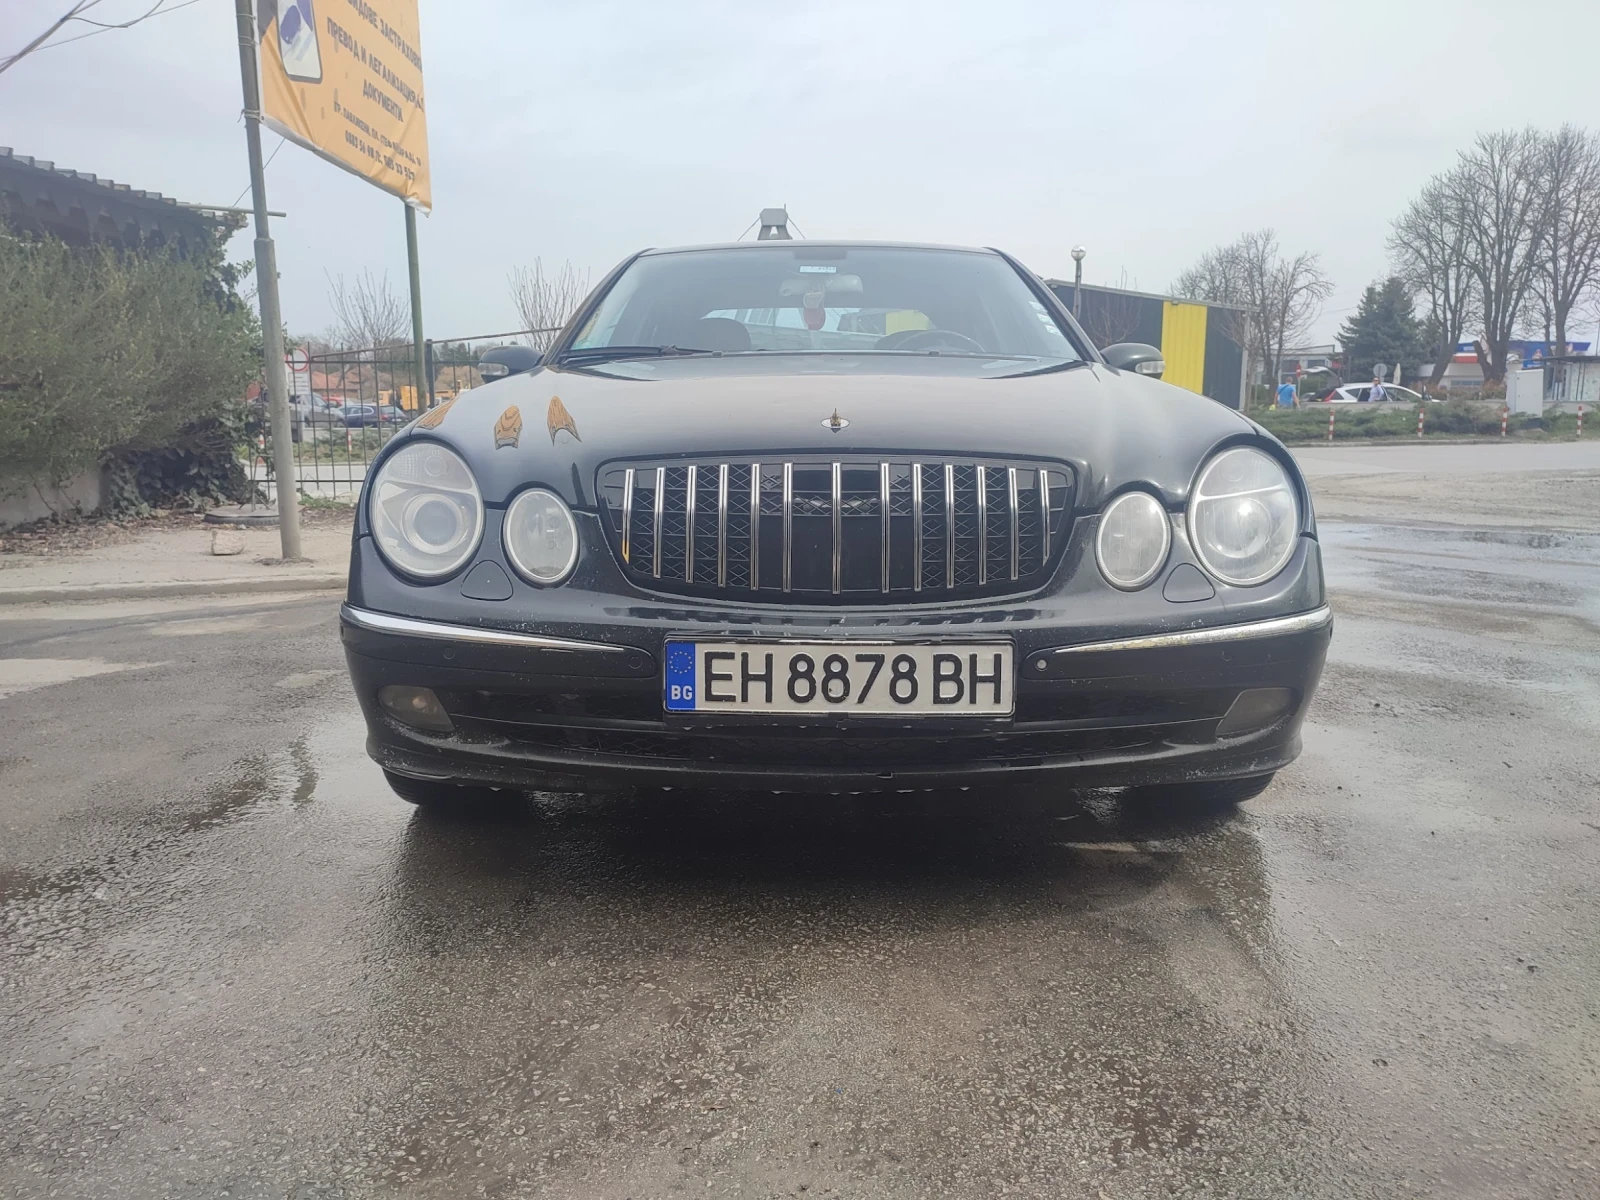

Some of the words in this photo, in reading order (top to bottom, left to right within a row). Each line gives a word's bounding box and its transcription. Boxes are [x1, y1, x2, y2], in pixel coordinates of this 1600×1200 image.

[327, 16, 360, 62] ПРЕВОД
[361, 45, 367, 65] И
[363, 79, 404, 122] ДОКУМЕНТИ
[671, 685, 693, 700] BG
[704, 651, 774, 703] EH
[787, 653, 919, 704] 8878
[932, 653, 1003, 705] BH
